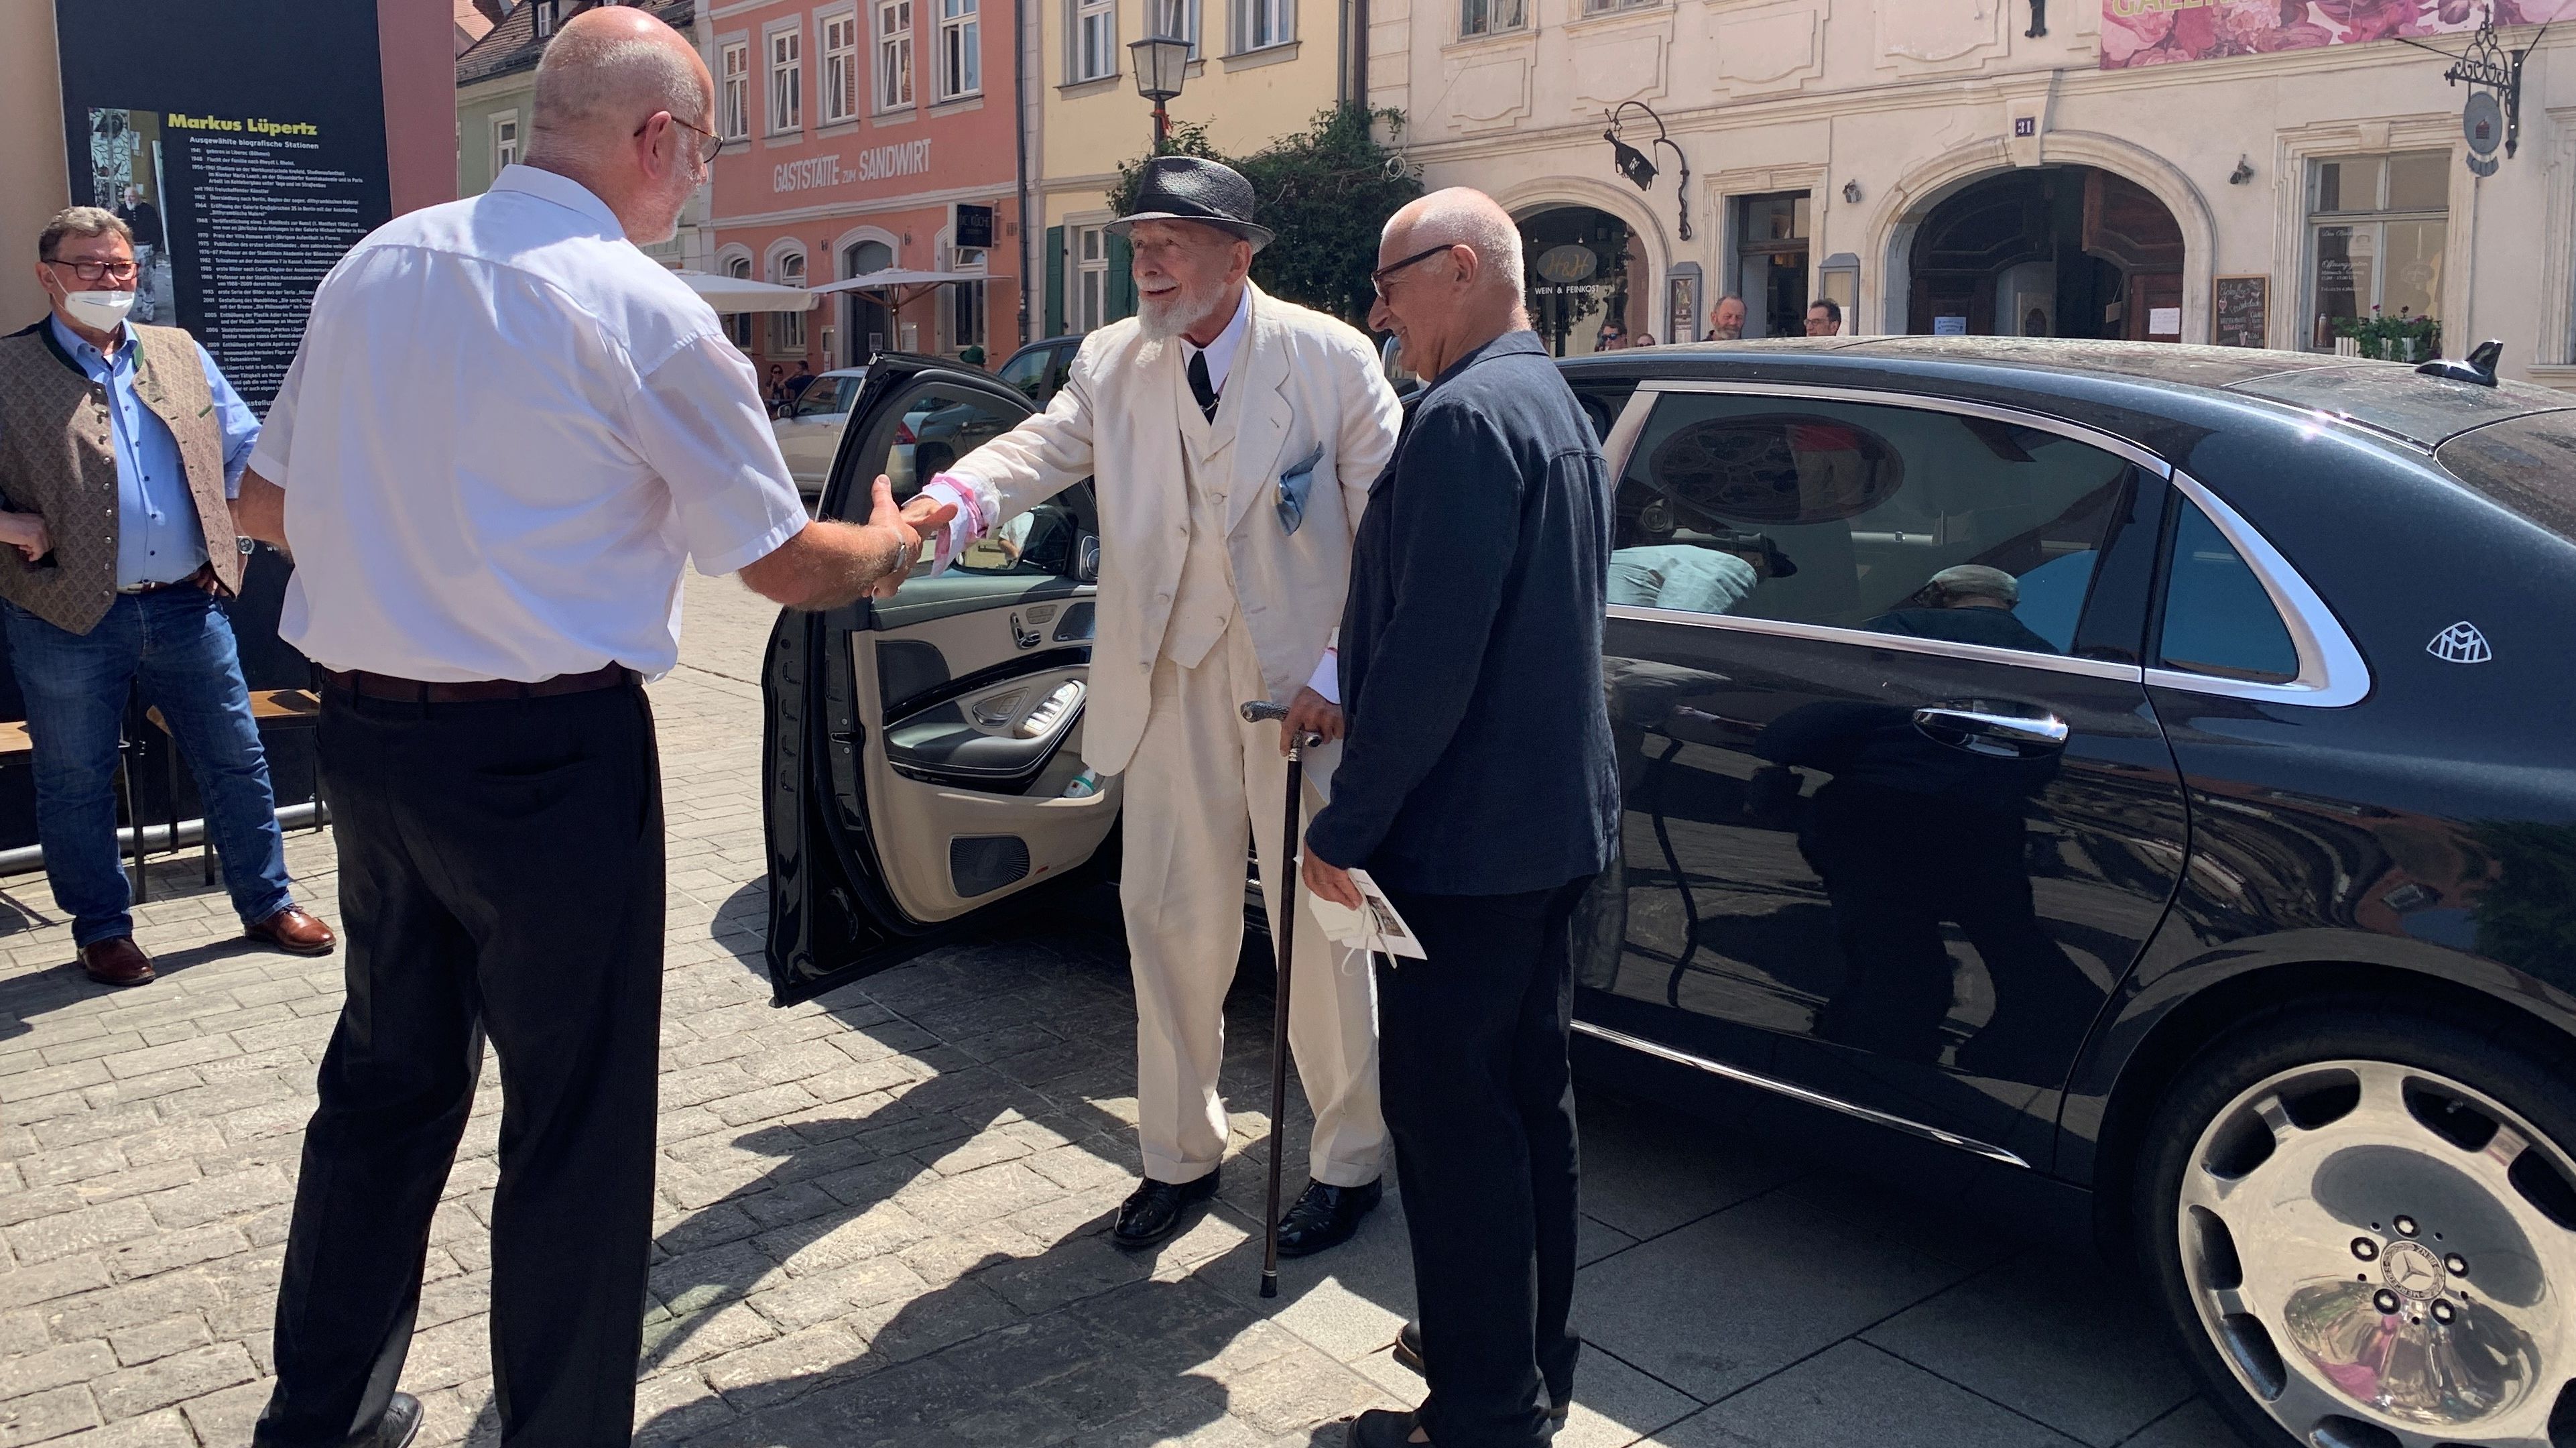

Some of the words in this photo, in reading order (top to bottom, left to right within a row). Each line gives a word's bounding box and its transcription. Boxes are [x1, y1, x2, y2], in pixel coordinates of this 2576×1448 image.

[168, 113, 242, 131] Markus
[247, 118, 317, 136] Lüpertz
[2018, 121, 2031, 133] 31
[190, 136, 236, 145] Ausgewählte
[238, 139, 282, 147] biografische
[773, 153, 840, 193] GASTSTÄTTE
[859, 138, 931, 181] SANDWIRT
[1535, 287, 1553, 295] WEIN
[1566, 285, 1599, 294] FEINKOST
[2416, 1246, 2437, 1265] BENZ
[2384, 1265, 2421, 1298] MERCEDES
